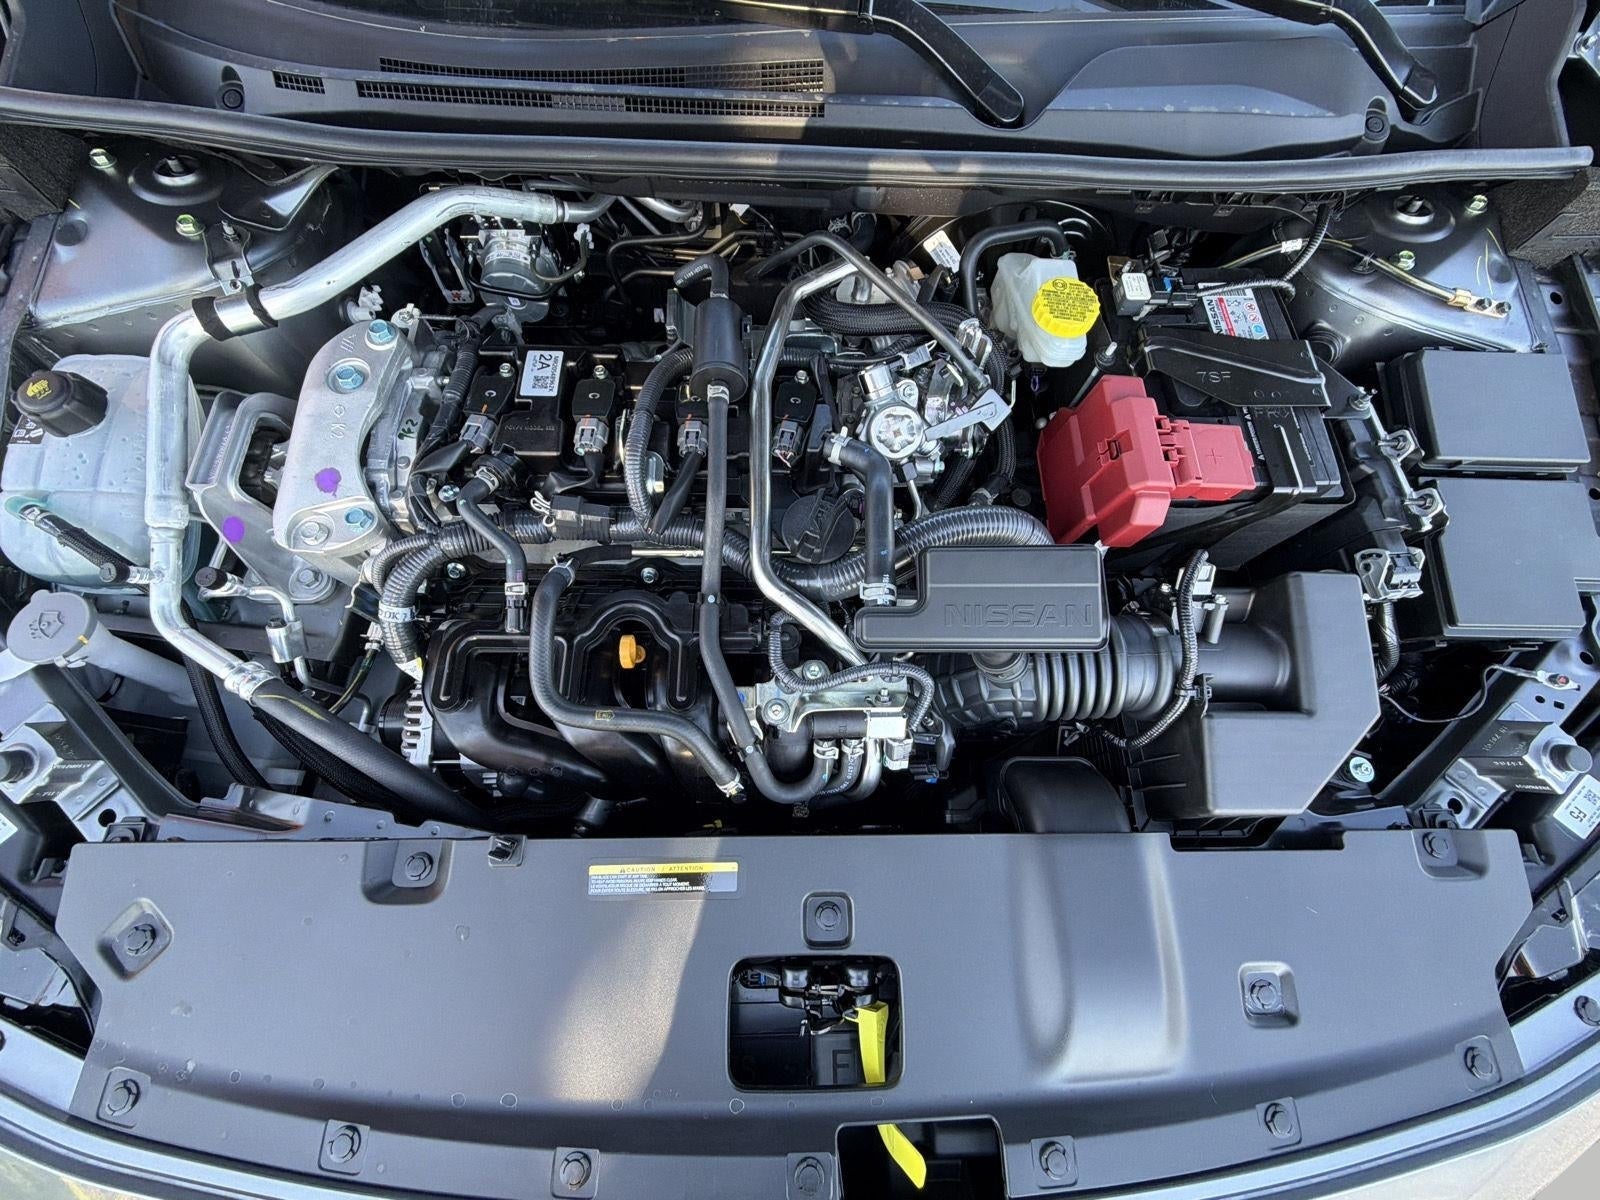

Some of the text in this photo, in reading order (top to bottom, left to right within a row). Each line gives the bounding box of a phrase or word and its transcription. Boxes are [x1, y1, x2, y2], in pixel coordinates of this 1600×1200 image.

[1206, 299, 1224, 333] NISSAN
[537, 353, 553, 371] 2A
[944, 603, 1094, 628] NISSAN
